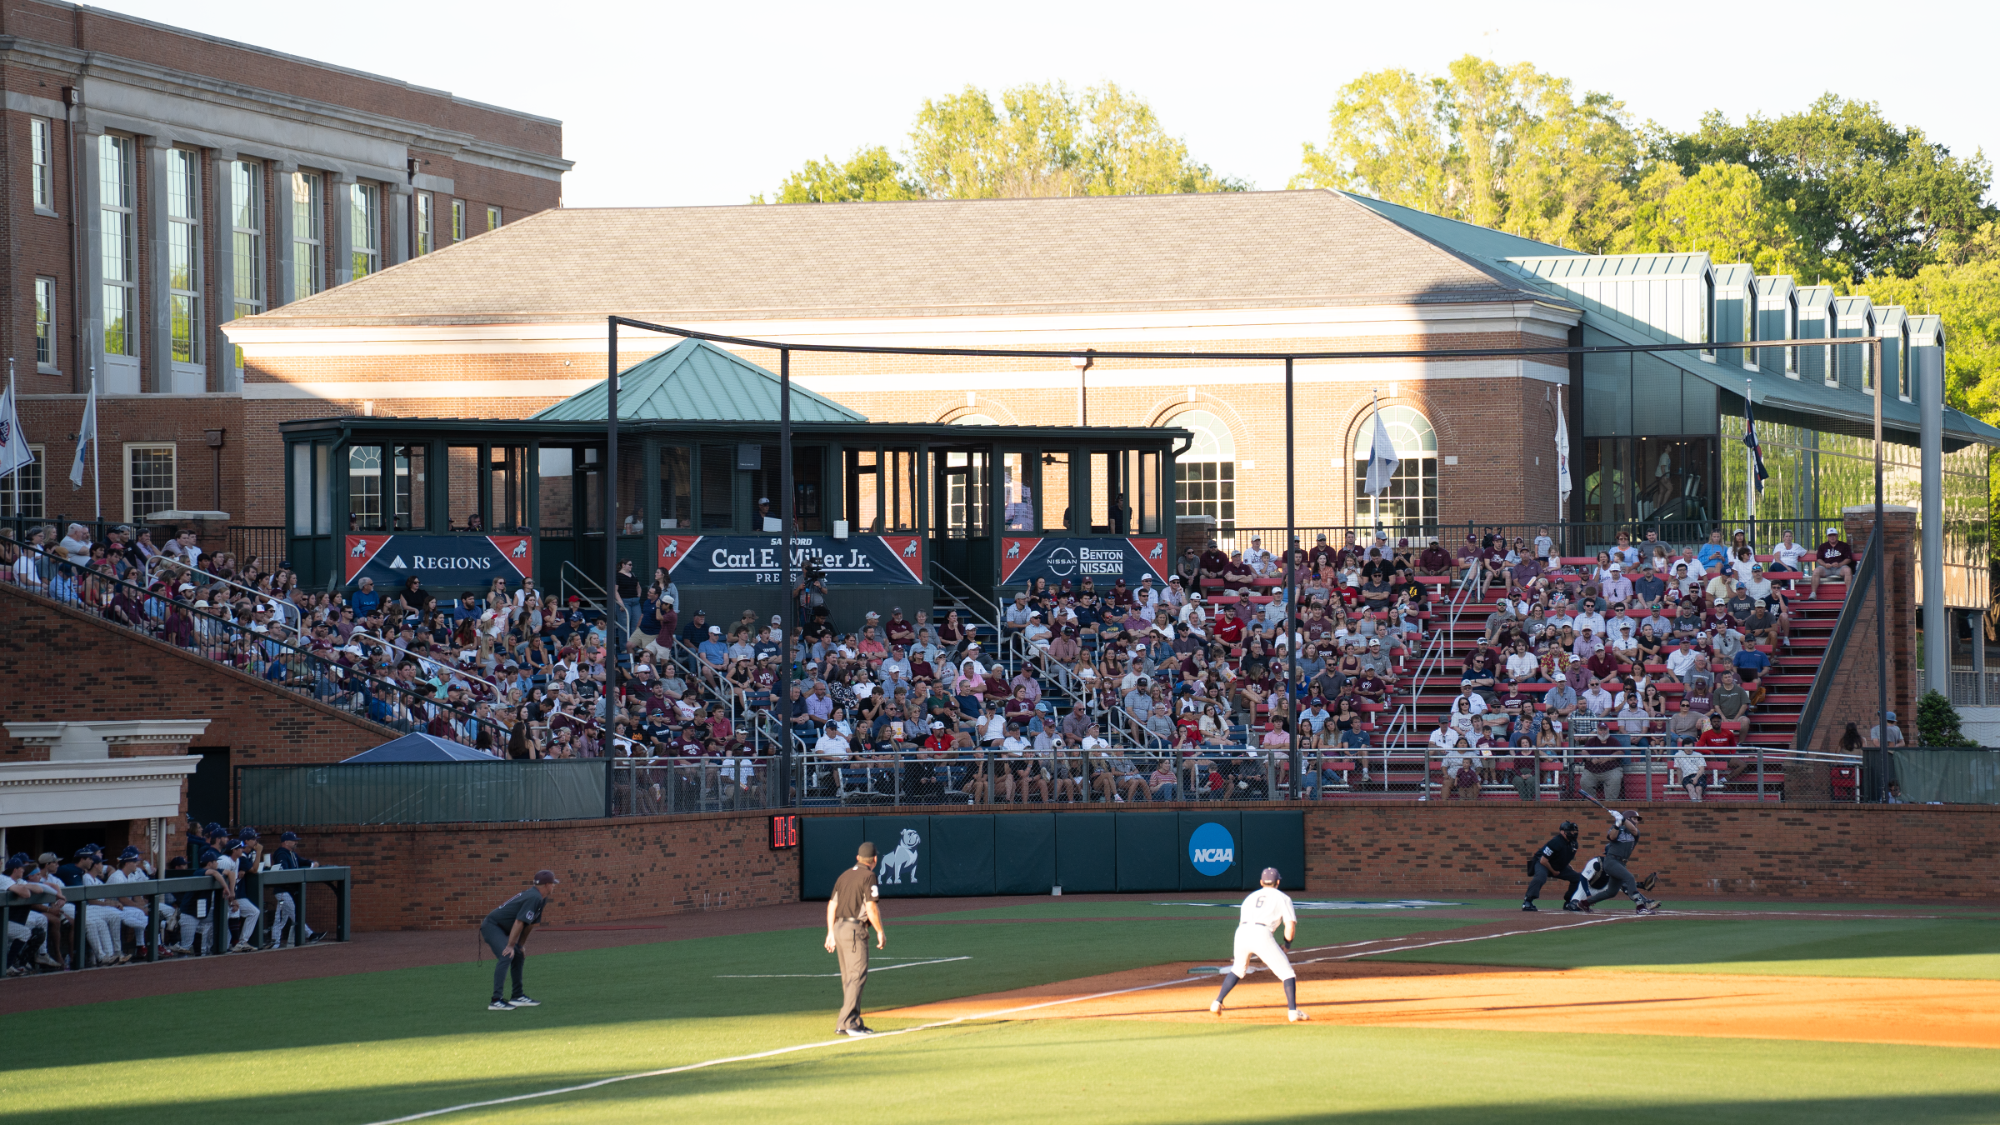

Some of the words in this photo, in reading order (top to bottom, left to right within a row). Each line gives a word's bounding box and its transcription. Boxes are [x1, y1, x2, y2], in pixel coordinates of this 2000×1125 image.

[771, 538, 813, 546] SAFORD
[711, 548, 756, 568] Carl
[760, 548, 780, 568] E.
[847, 549, 870, 568] Jr.
[1080, 547, 1123, 560] BENTON
[413, 555, 491, 570] REGIONS
[1080, 563, 1123, 573] NISSAN
[756, 573, 797, 583] PRES
[1690, 696, 1710, 704] STATE
[1193, 848, 1233, 862] NCAA
[1255, 895, 1266, 908] 6
